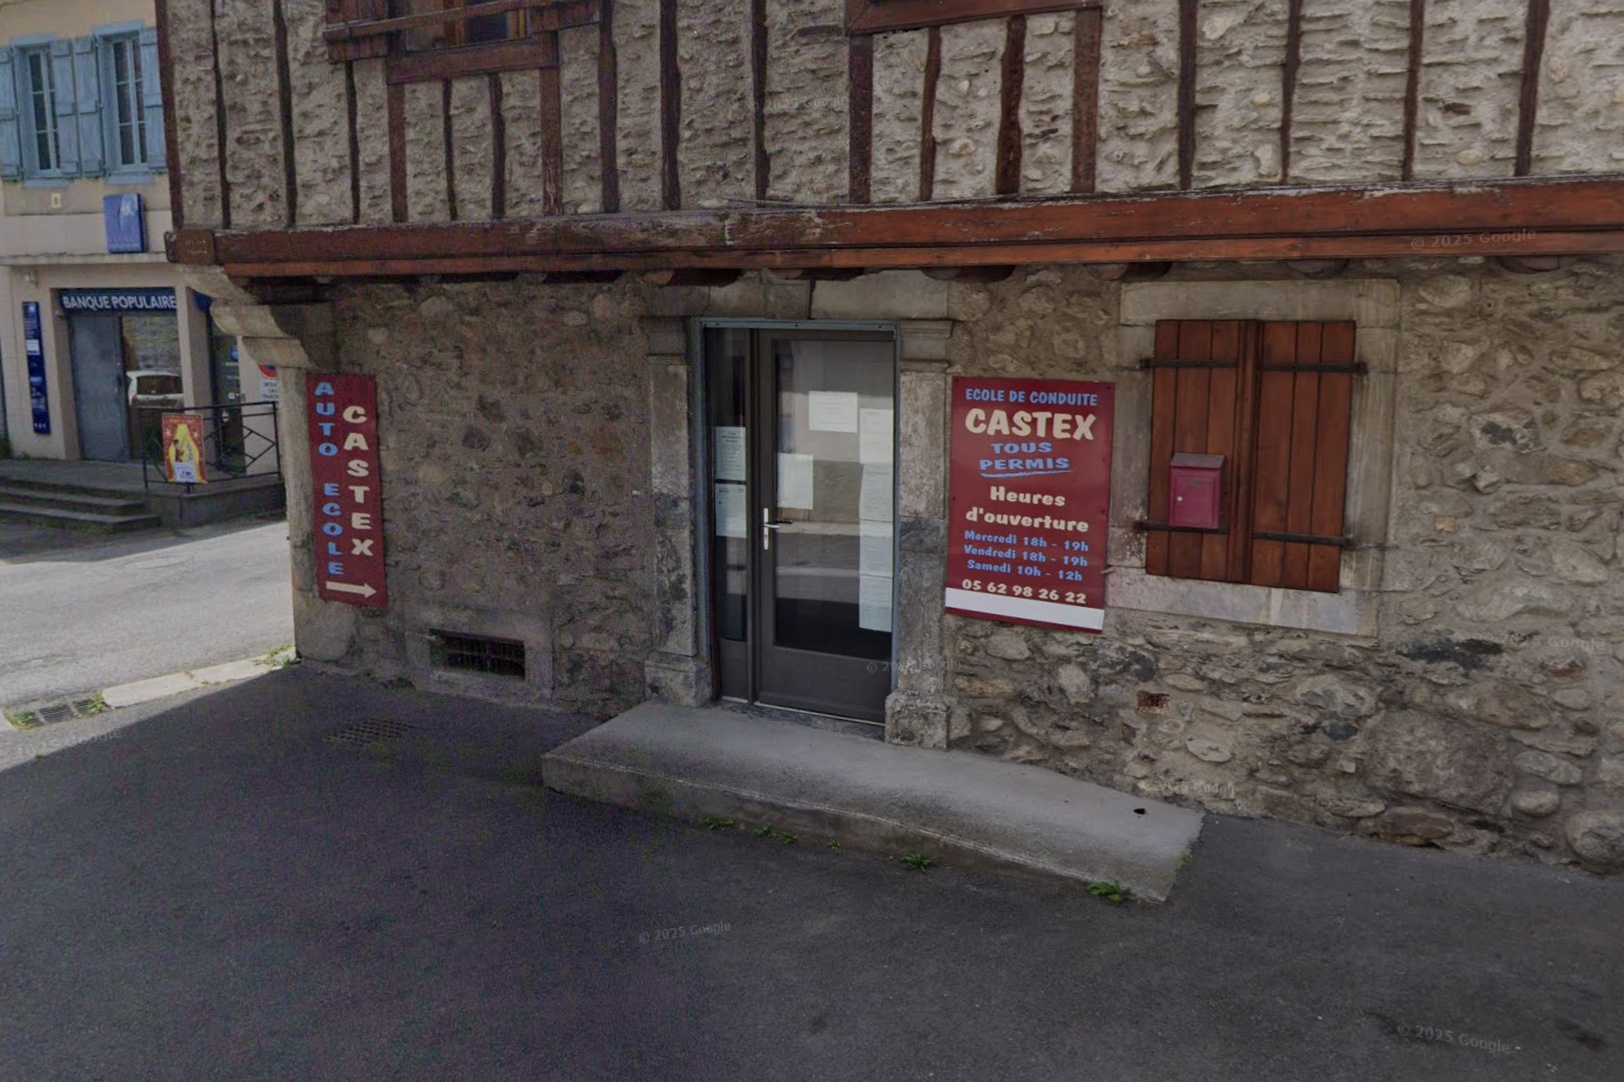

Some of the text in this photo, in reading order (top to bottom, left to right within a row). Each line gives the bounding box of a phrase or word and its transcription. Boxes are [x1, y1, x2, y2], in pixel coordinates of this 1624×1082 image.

[63, 295, 177, 311] BANQUE POPULAIRE
[965, 388, 1098, 406] ECOLE DE CONDUITE
[965, 407, 1097, 441] CASTEX
[990, 441, 1053, 454] TOUS
[979, 457, 1070, 471] PERMIS
[314, 381, 345, 575] AUTO ECOLE
[342, 405, 374, 557] CASTEX
[990, 485, 1066, 507] Heures
[965, 507, 1089, 533] d'ouverture
[964, 530, 1017, 545] Mercredi
[1023, 536, 1047, 548] 18h
[1064, 540, 1089, 552] 19h
[964, 544, 1016, 559] Vendredi
[1022, 551, 1046, 563] 18h
[1063, 555, 1088, 567] 19h
[967, 559, 1011, 574] Samedi
[1017, 566, 1041, 577] 10h
[1058, 569, 1082, 582] 12h
[962, 578, 1086, 604] 05 62 98 26 22
